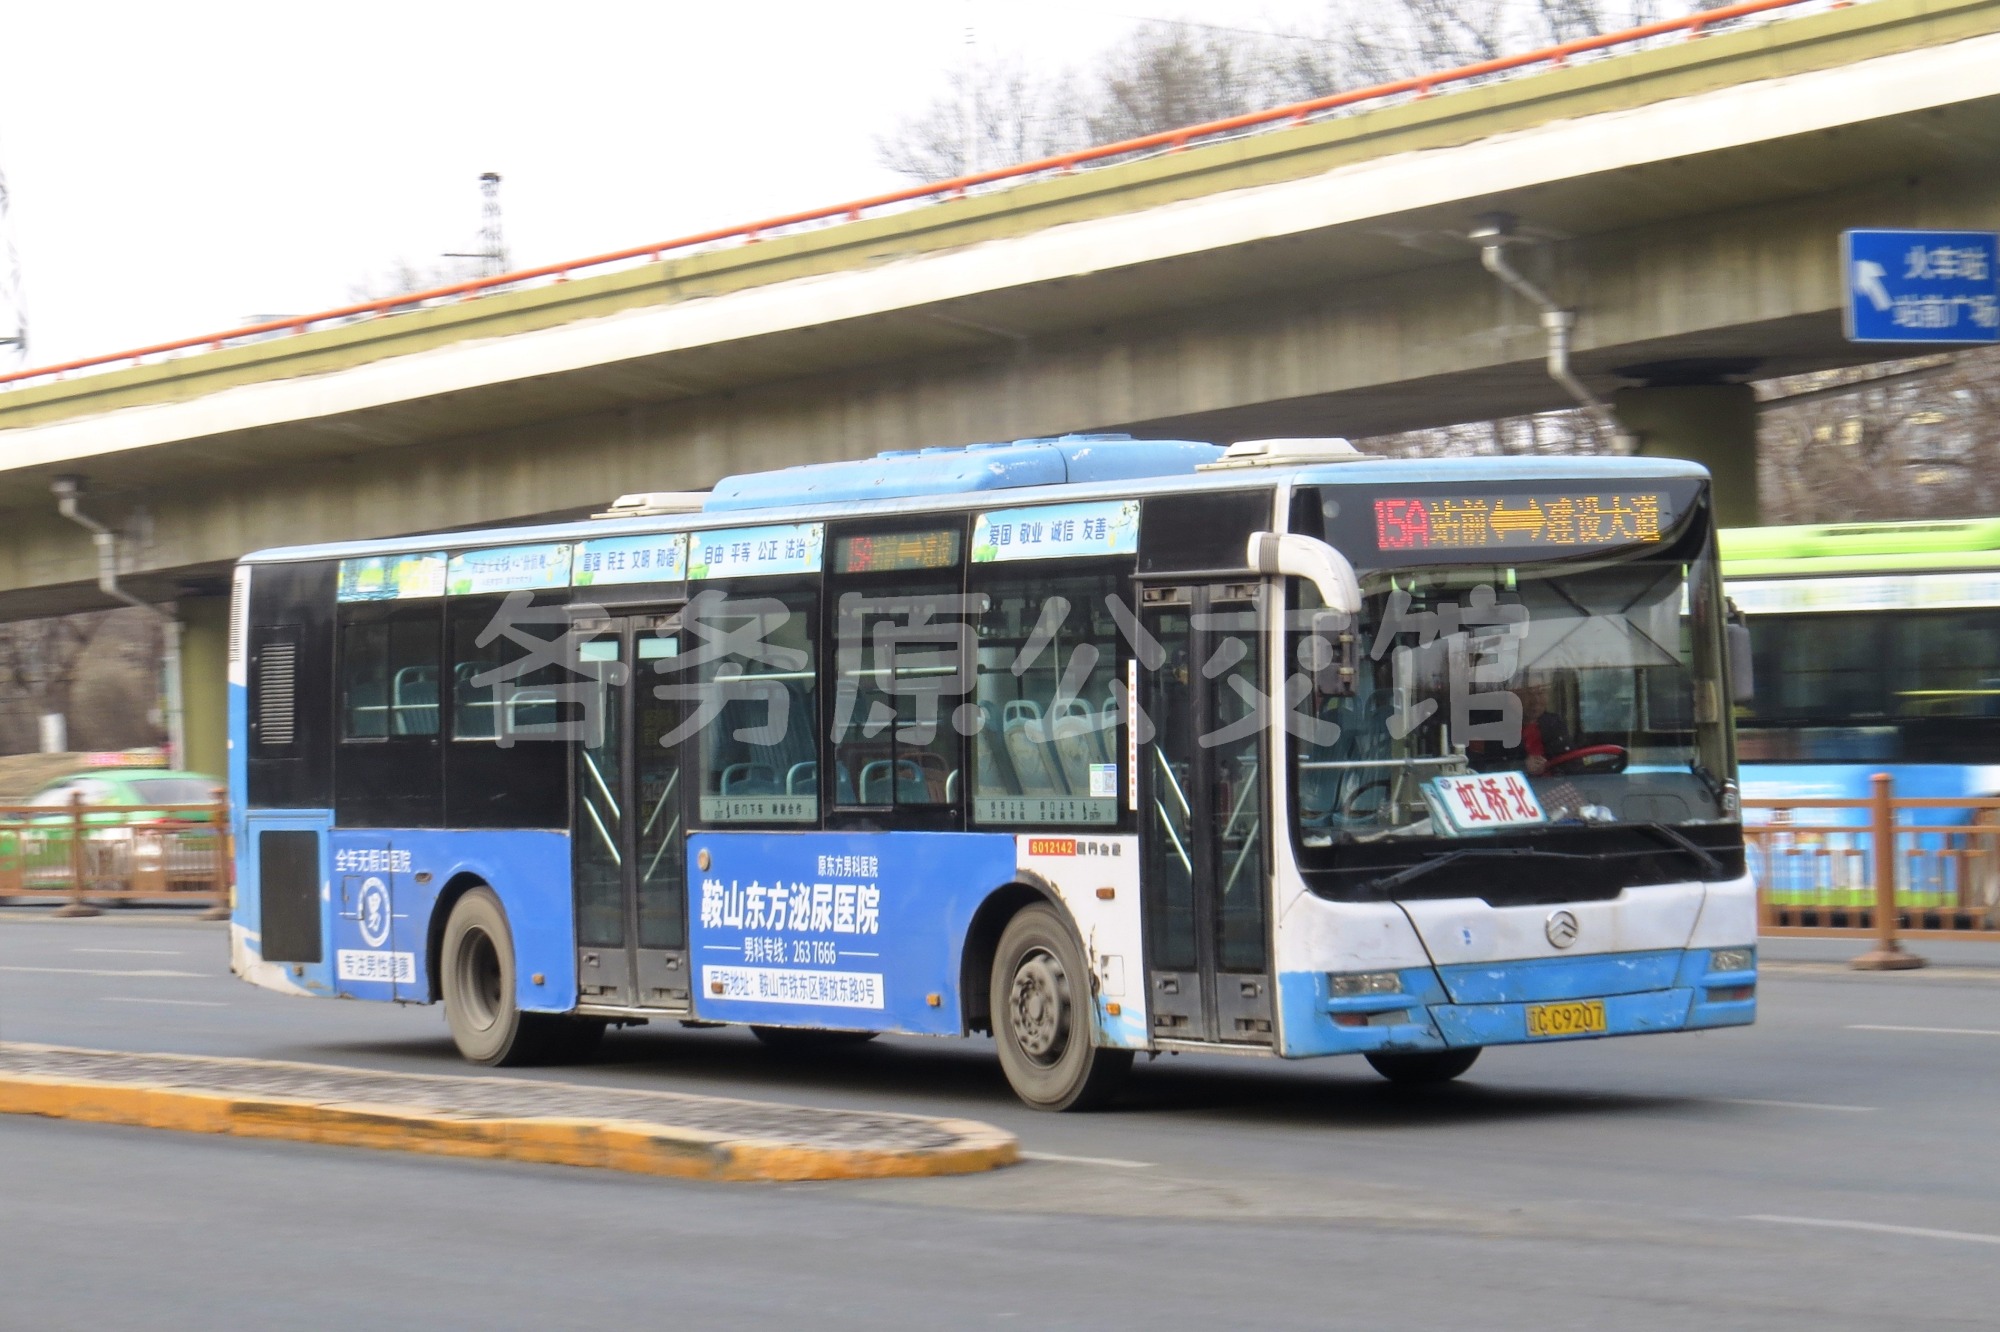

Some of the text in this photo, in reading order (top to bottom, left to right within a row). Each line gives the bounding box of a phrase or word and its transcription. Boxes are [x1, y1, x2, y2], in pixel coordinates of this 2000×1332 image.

[989, 516, 1107, 546] 爱国 敬业 诚信 友善
[1375, 498, 1428, 548] 15A
[1545, 495, 1661, 544] 建设大道
[583, 546, 678, 572] 富强 民主 文明 和谐
[704, 537, 806, 565] 自由 平等 公正 法治
[1455, 775, 1539, 822] 虹桥北
[335, 848, 412, 874] 全年无假日医院
[1032, 841, 1073, 854] 6012142
[817, 854, 879, 878] 原东方男科医院
[701, 878, 880, 935] 鞍山东方泌尿医院
